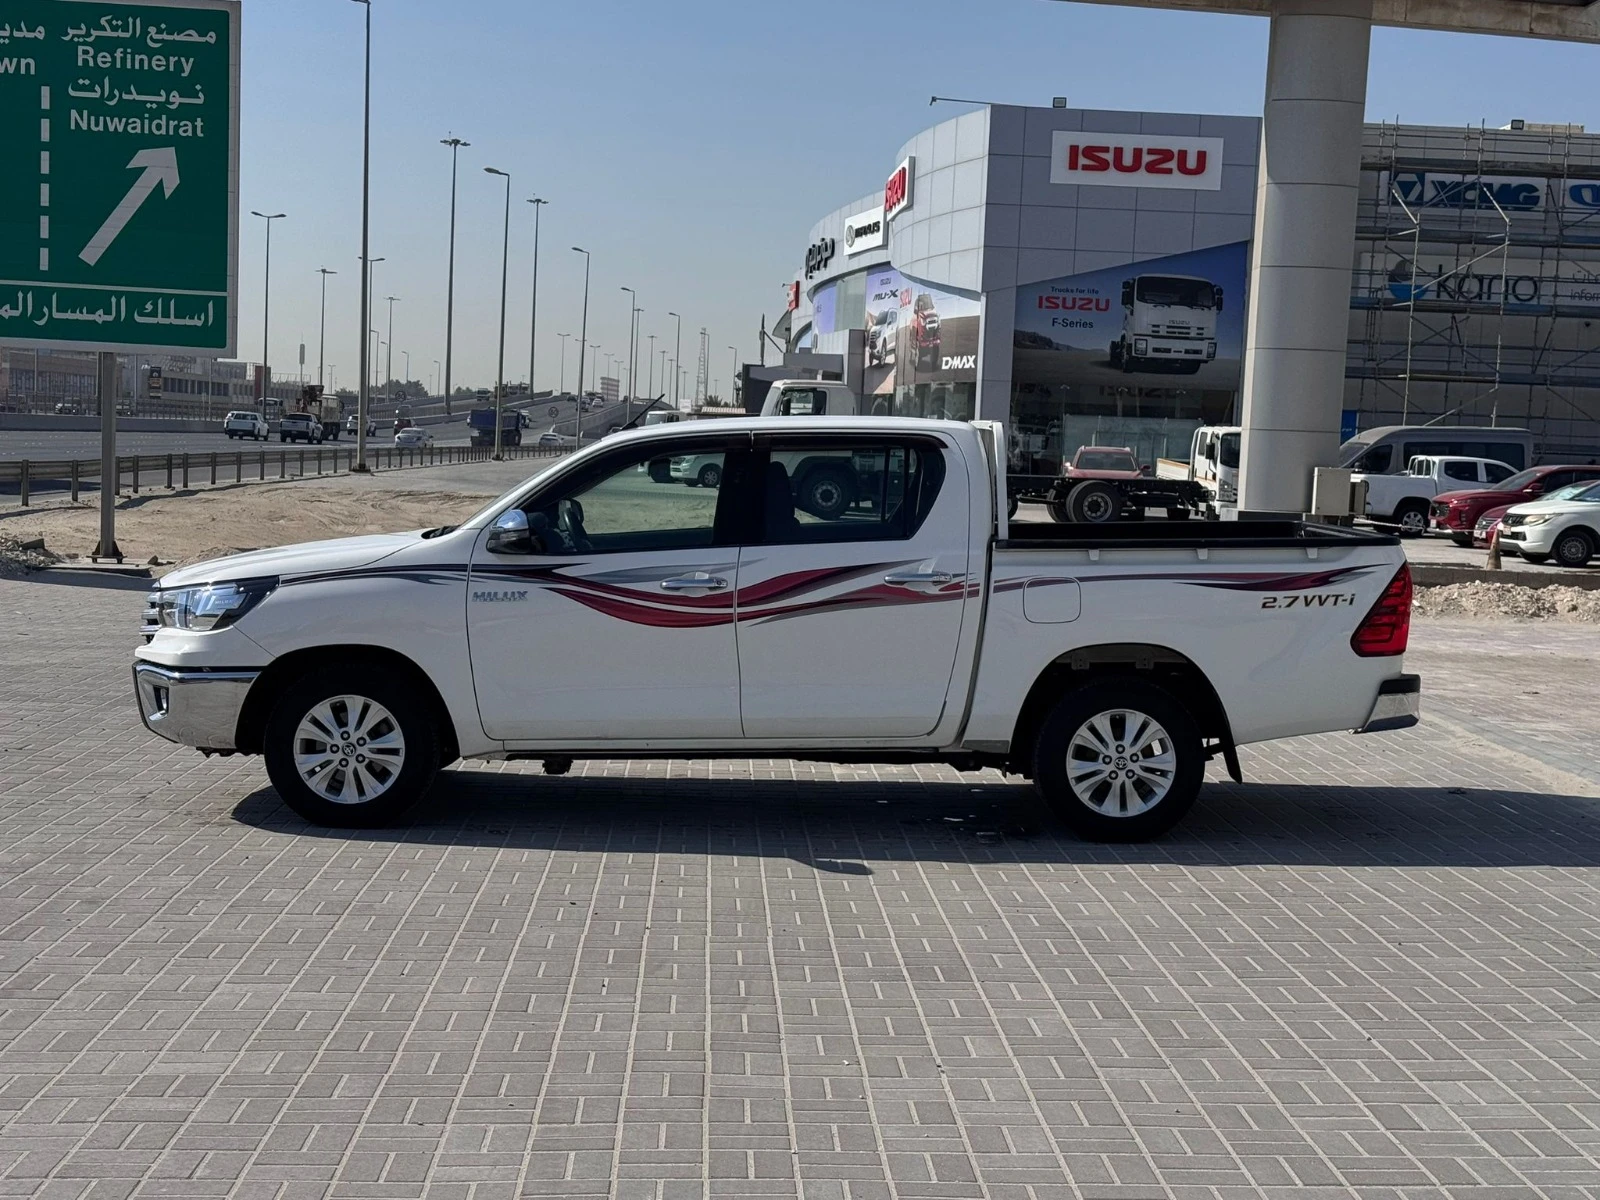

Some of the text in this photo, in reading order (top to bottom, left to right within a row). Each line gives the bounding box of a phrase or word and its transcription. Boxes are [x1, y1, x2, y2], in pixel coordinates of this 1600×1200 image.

[61, 15, 217, 47] مصنع التكرير
[77, 46, 194, 77] Refinery
[68, 76, 205, 109] نويدرات
[70, 109, 204, 137] Nuwaidrat
[1068, 144, 1207, 175] ISUZU
[1431, 179, 1540, 210] XCMG
[1051, 286, 1074, 294] Trucks
[1086, 287, 1099, 295] life
[1436, 264, 1538, 302] kano
[33, 291, 126, 326] المسار
[134, 297, 214, 327] اسلك
[1038, 295, 1110, 312] ISUZU
[1052, 318, 1094, 329] F-Series
[472, 591, 528, 602] HILUX
[1261, 593, 1356, 609] 2.7 VVT-i
